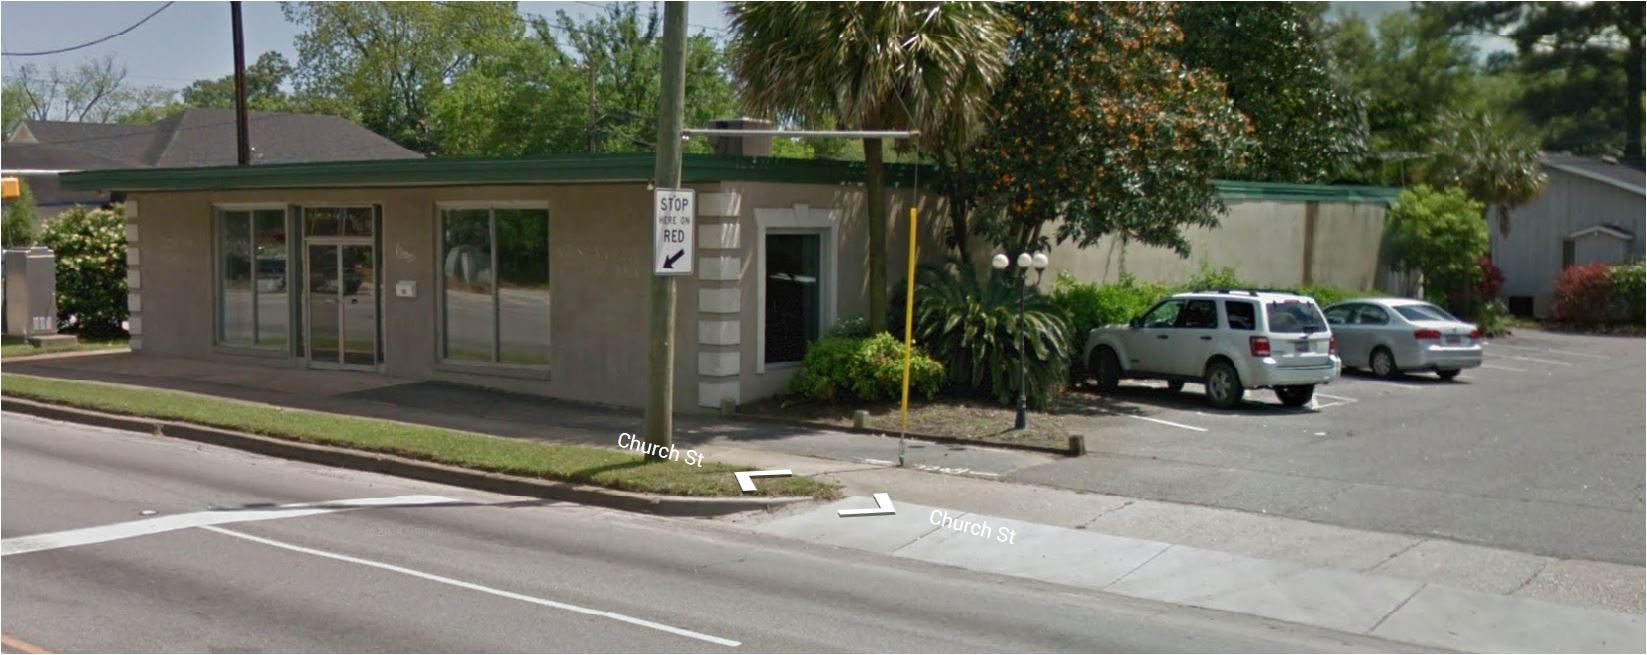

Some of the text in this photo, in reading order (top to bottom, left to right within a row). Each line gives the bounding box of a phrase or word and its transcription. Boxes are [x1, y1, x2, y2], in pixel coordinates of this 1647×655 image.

[660, 198, 689, 212] STOP
[659, 216, 690, 225] HERE ON
[663, 229, 685, 243] RED
